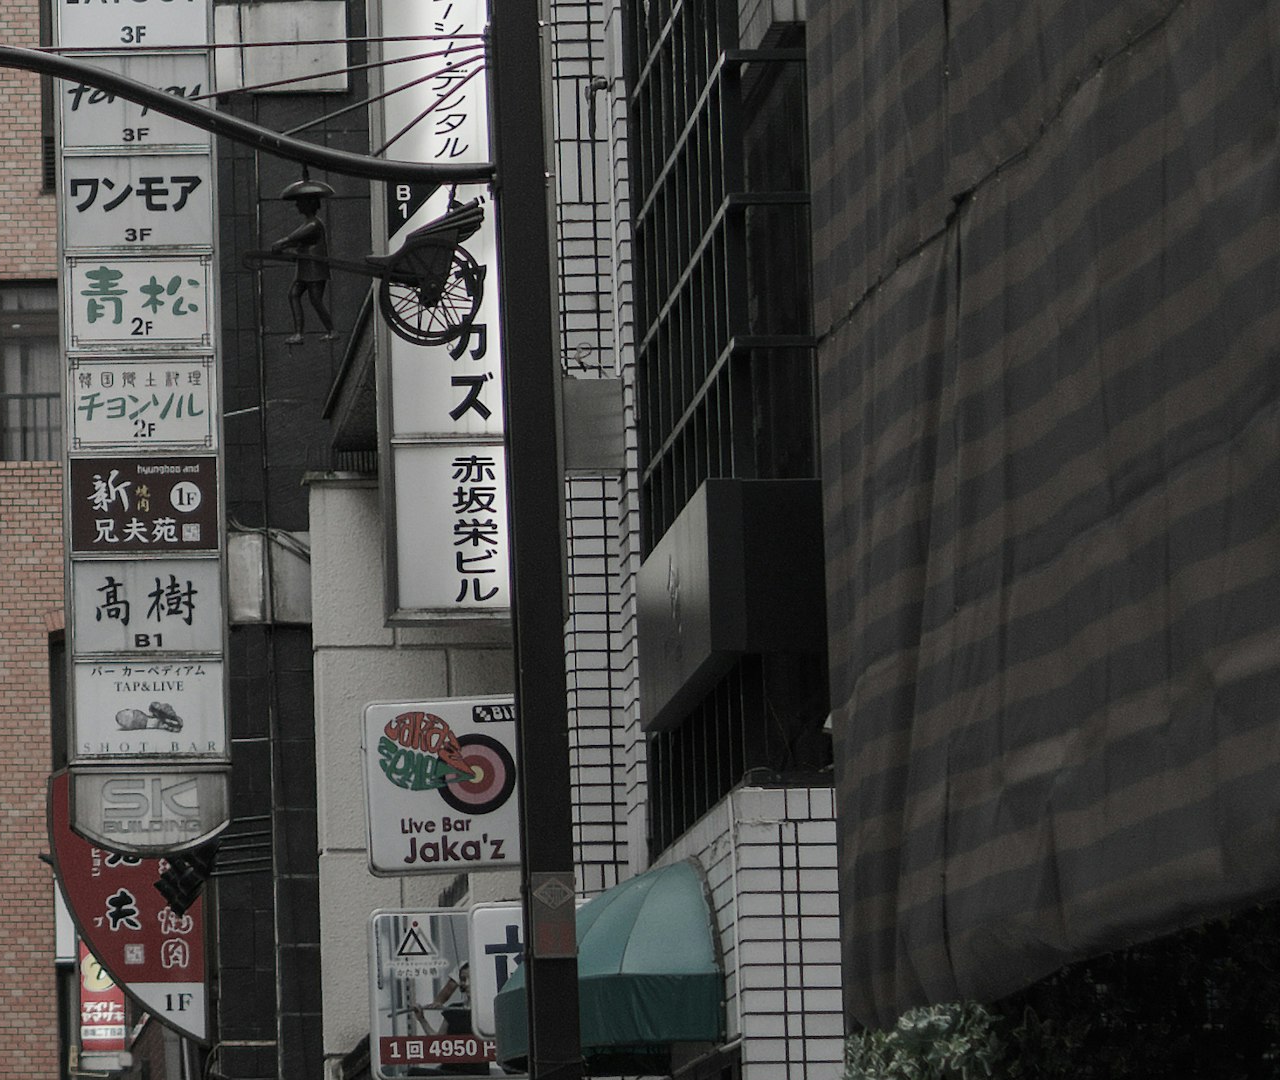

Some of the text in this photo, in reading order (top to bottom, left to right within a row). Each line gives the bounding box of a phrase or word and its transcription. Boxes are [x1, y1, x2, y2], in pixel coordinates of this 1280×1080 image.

[121, 26, 146, 43] 3F
[122, 127, 149, 142] 3F
[70, 176, 202, 213] ワンモア
[124, 228, 152, 242] 3F
[80, 266, 200, 324] 青松
[131, 318, 153, 336] 2F
[78, 393, 204, 420] チョンソル
[133, 419, 156, 438] 2F
[88, 470, 198, 513] 新 焼肉 1F
[93, 516, 178, 544] 兄夫苑
[451, 455, 498, 603] 赤坂栄ビル
[95, 574, 197, 626] 高樹
[134, 633, 163, 648] B1
[91, 664, 206, 677] バー カーペディアム
[113, 681, 184, 692] TAP&LIVE
[82, 742, 218, 753] SHOT BAR
[101, 778, 201, 818] SK
[103, 821, 202, 834] BUILDING
[401, 816, 472, 834] Live Bar
[404, 833, 505, 865] Jaka'z
[157, 906, 194, 969] 焼肉
[165, 992, 194, 1011] 1F
[389, 1040, 478, 1059] 1 回 4950
